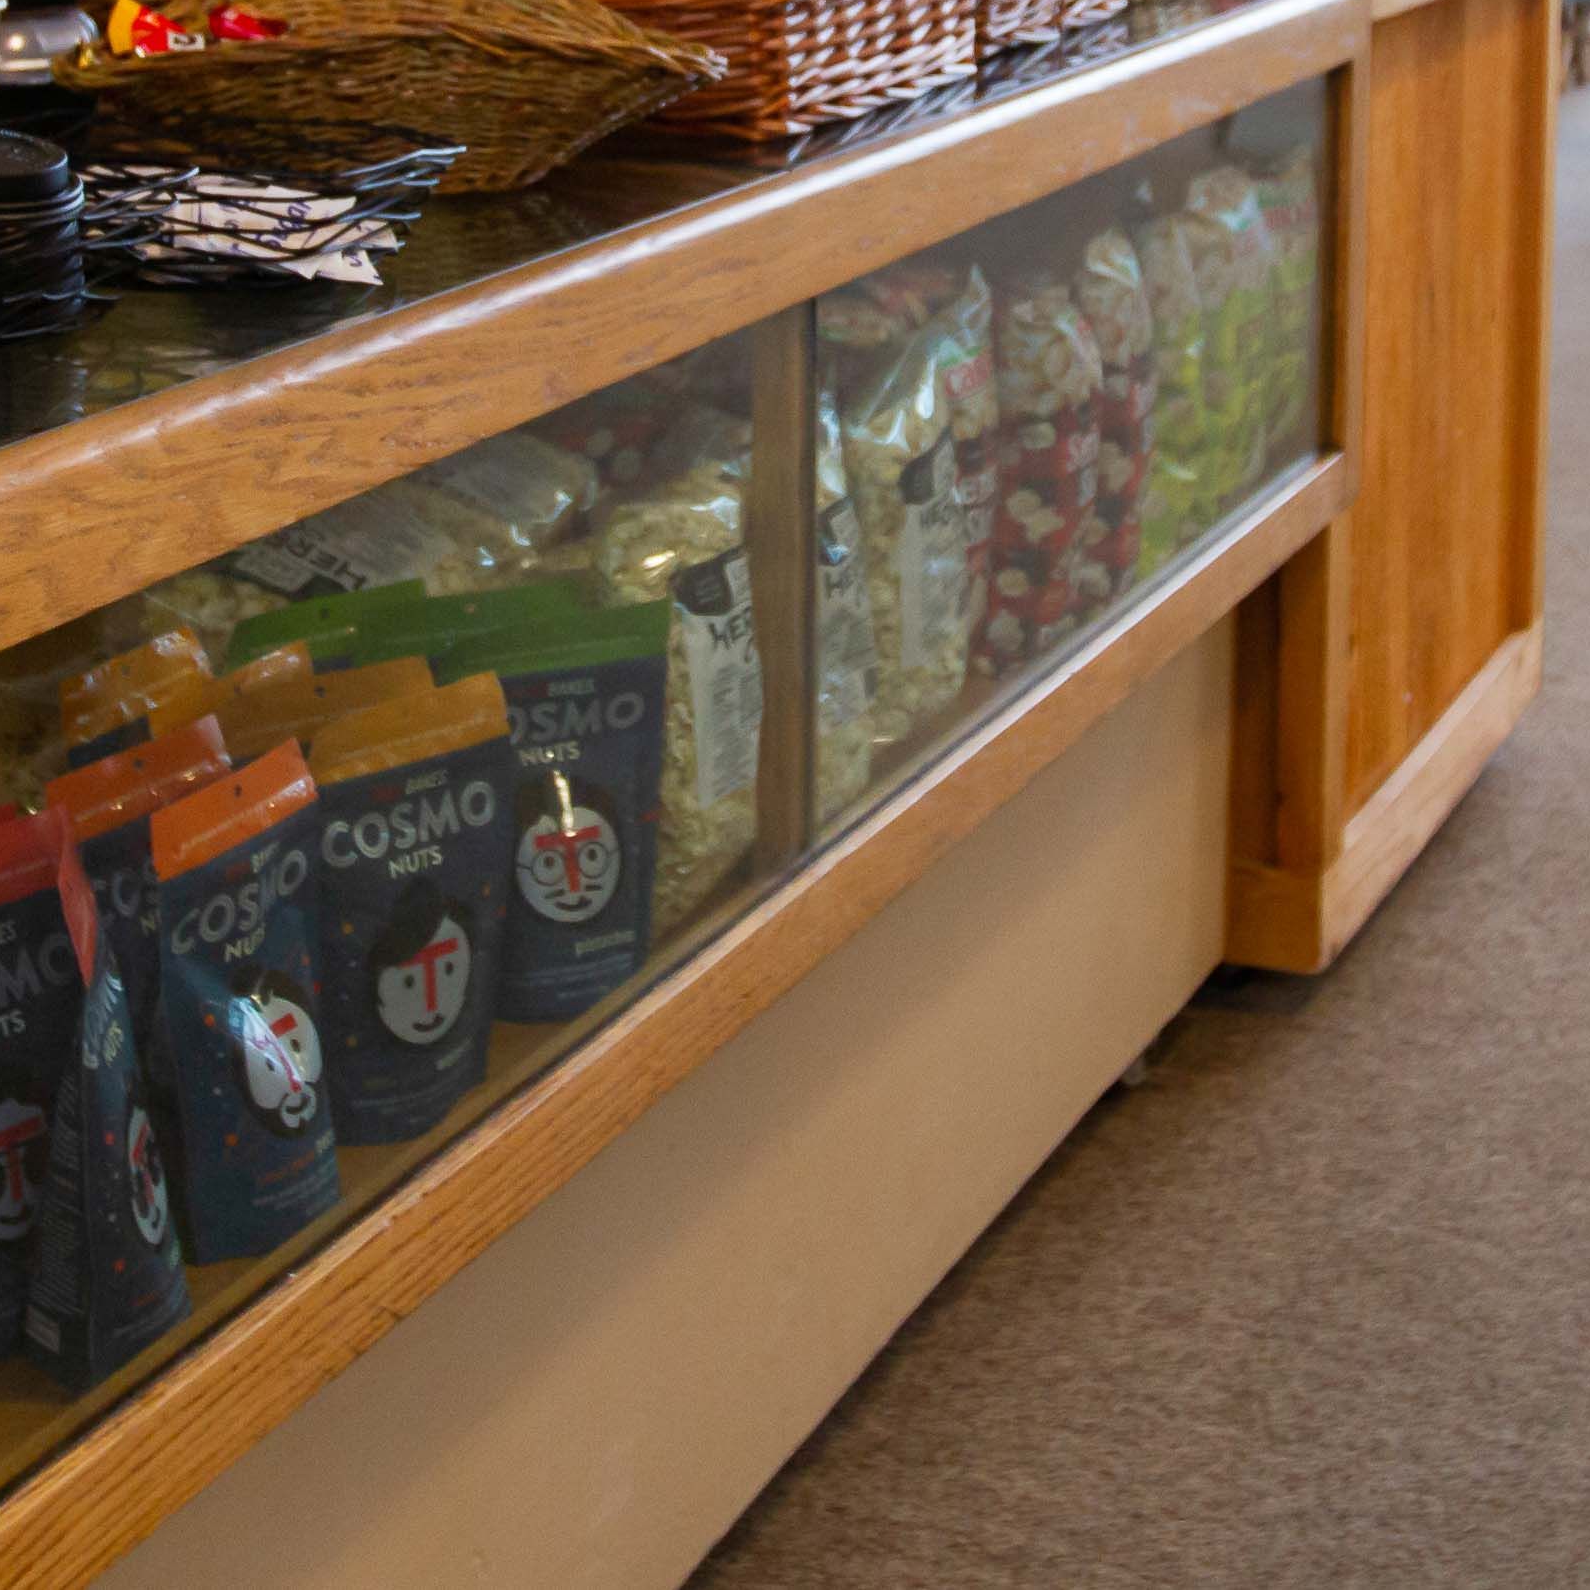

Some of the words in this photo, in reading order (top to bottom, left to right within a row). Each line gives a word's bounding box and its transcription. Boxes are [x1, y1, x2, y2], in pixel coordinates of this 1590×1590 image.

[506, 691, 646, 745] OSMO
[519, 741, 581, 767] NUTS
[322, 781, 496, 869] COSMO
[388, 845, 444, 880] NUTS
